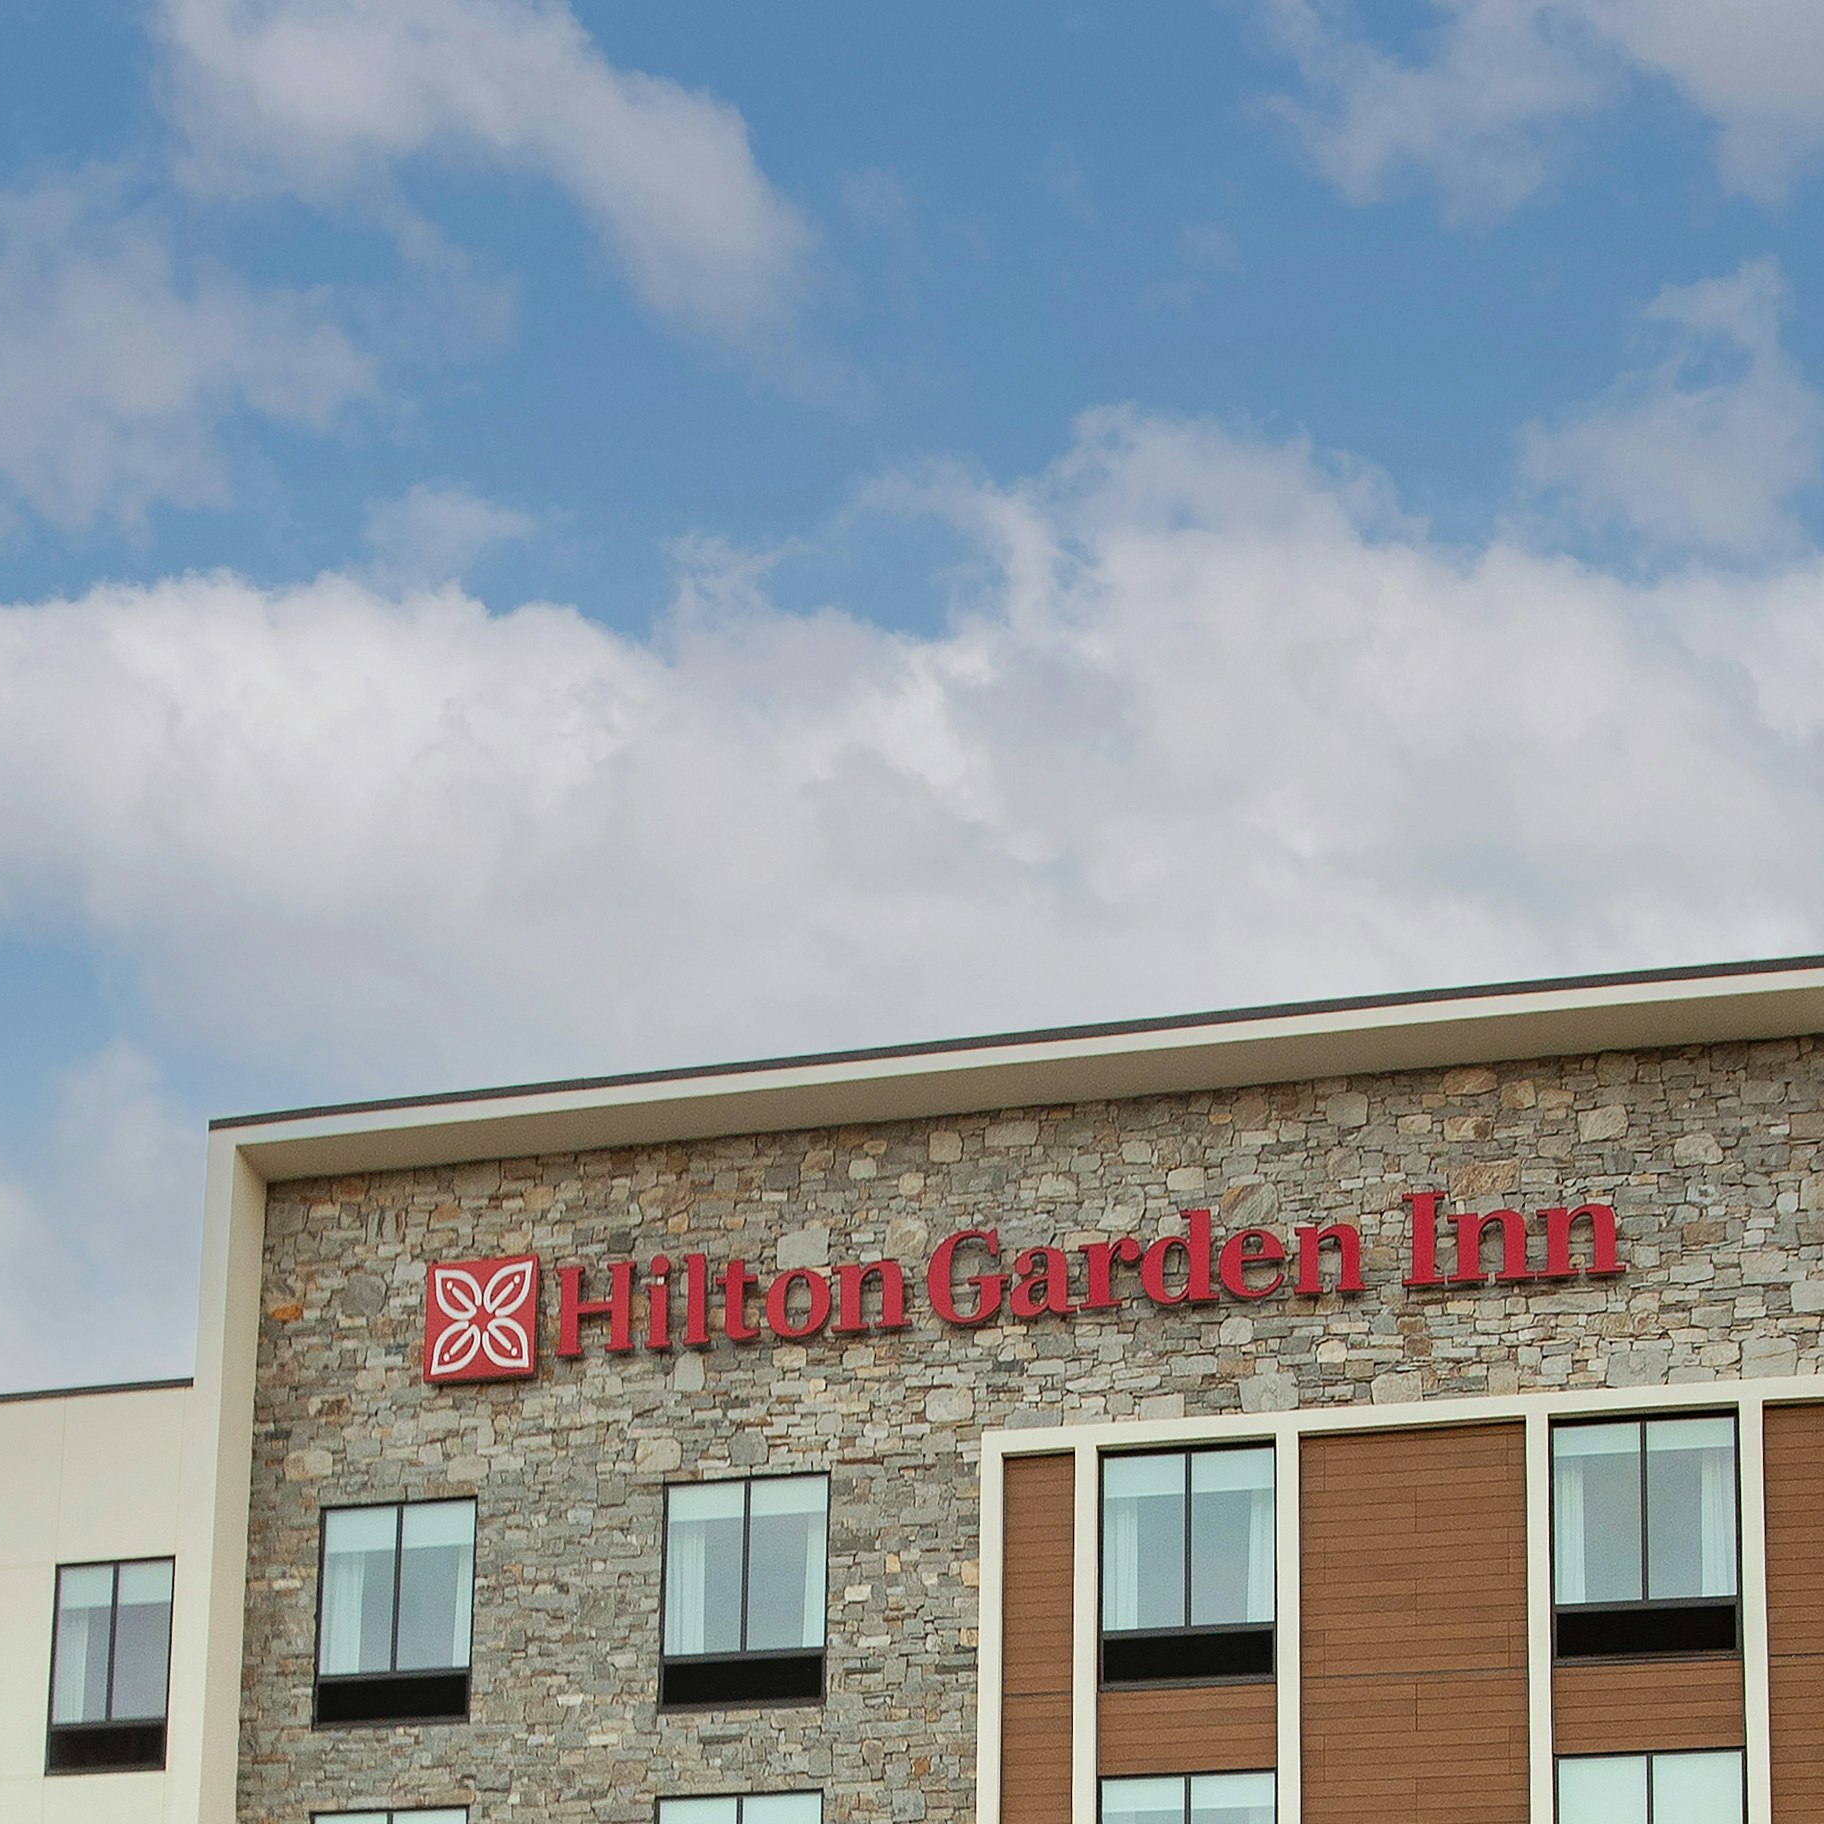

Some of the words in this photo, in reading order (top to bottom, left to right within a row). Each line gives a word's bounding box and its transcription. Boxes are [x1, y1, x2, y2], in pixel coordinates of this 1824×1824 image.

[555, 1253, 912, 1358] Hilton
[927, 1209, 1367, 1327] Garden
[1401, 1190, 1627, 1288] Inn
